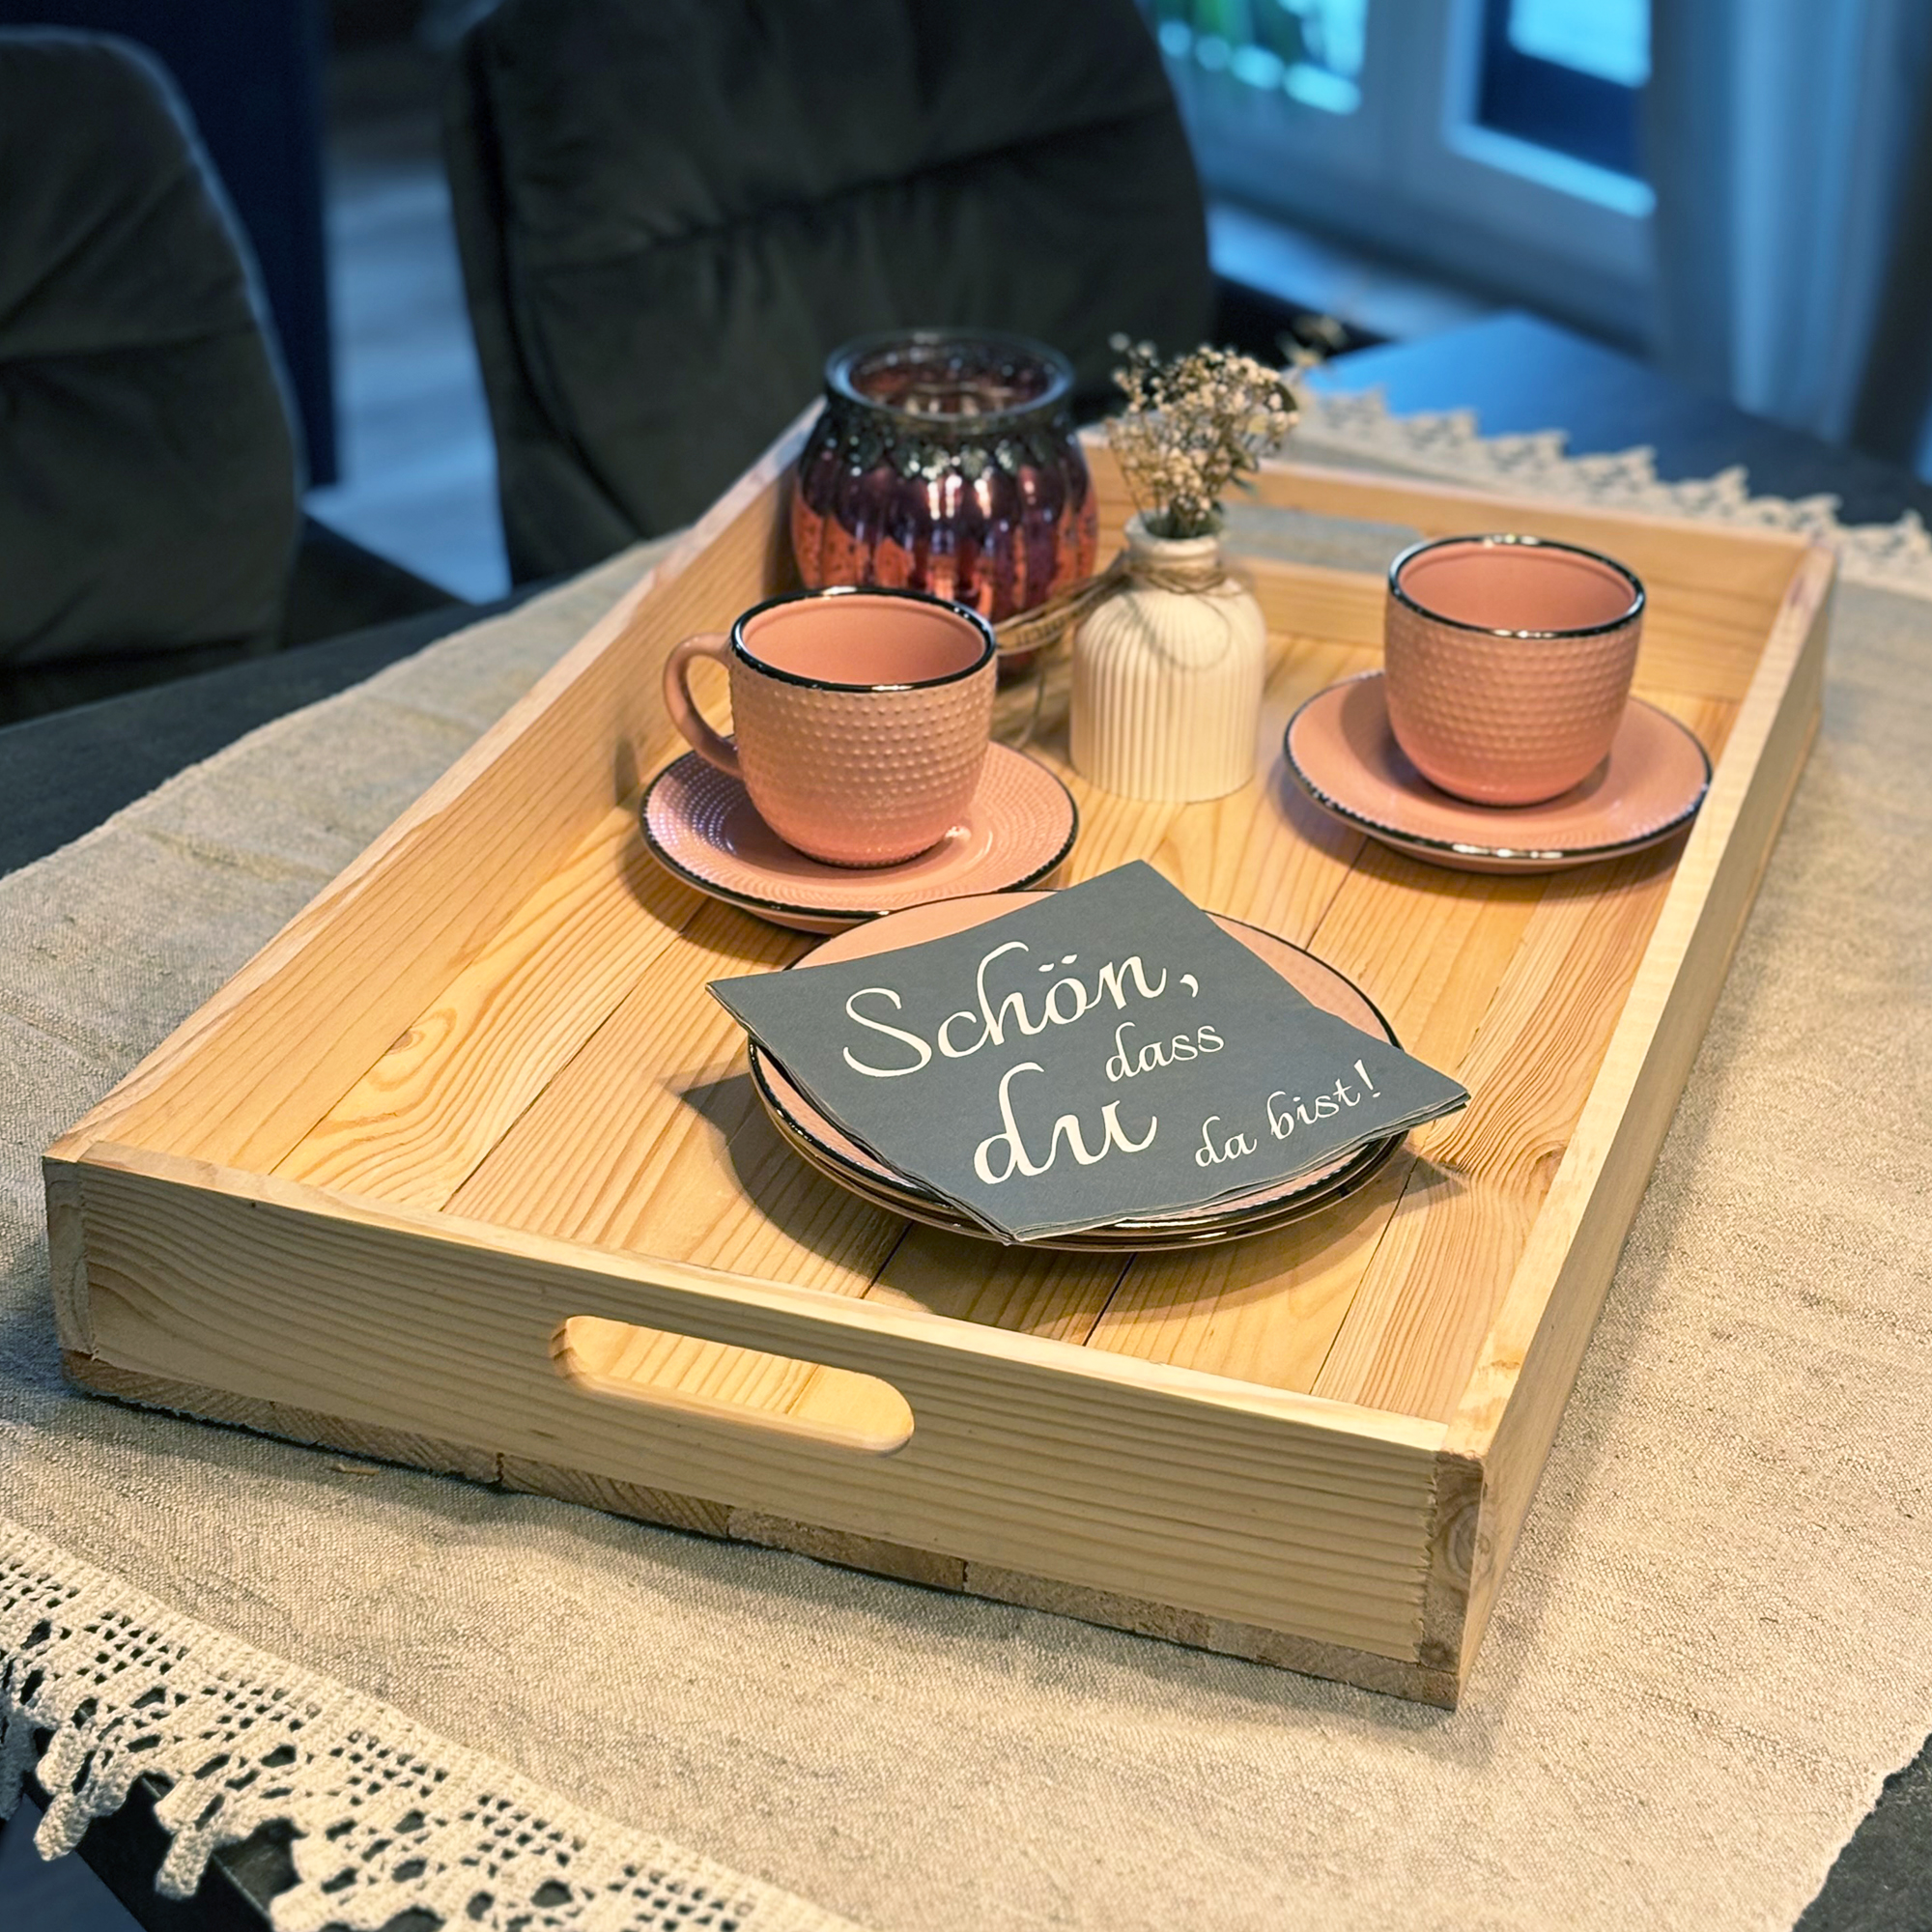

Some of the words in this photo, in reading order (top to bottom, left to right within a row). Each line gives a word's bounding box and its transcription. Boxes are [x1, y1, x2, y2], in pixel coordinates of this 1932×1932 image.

[842, 941, 1199, 1077] Schön,
[1105, 1022, 1225, 1082] dass
[973, 1062, 1158, 1185] du
[1194, 1116, 1258, 1168] da
[1267, 1060, 1381, 1140] bist!
